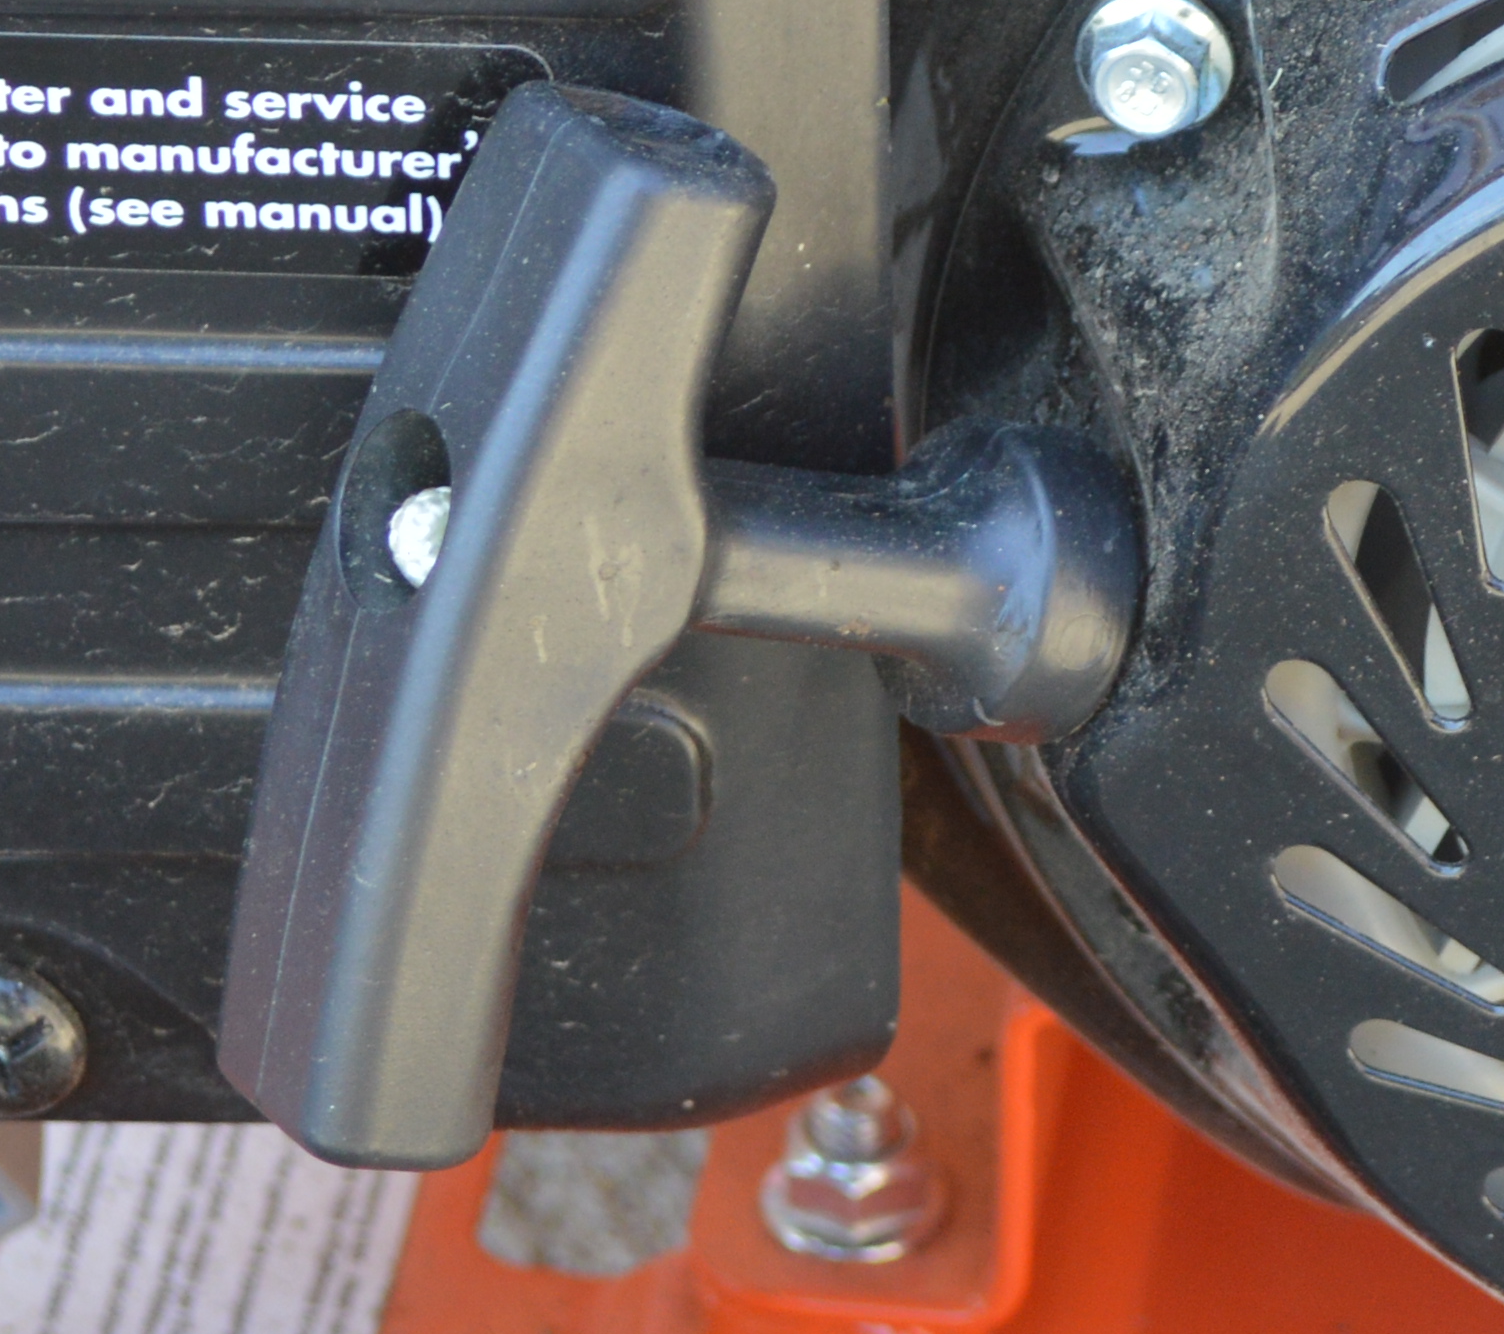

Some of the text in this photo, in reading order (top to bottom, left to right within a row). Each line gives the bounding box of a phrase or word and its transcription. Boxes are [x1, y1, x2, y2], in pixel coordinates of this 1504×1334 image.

[89, 75, 204, 118] and
[224, 80, 427, 124] service
[66, 130, 479, 179] manufacturer'
[68, 185, 185, 235] (see
[204, 192, 443, 244] manual)
